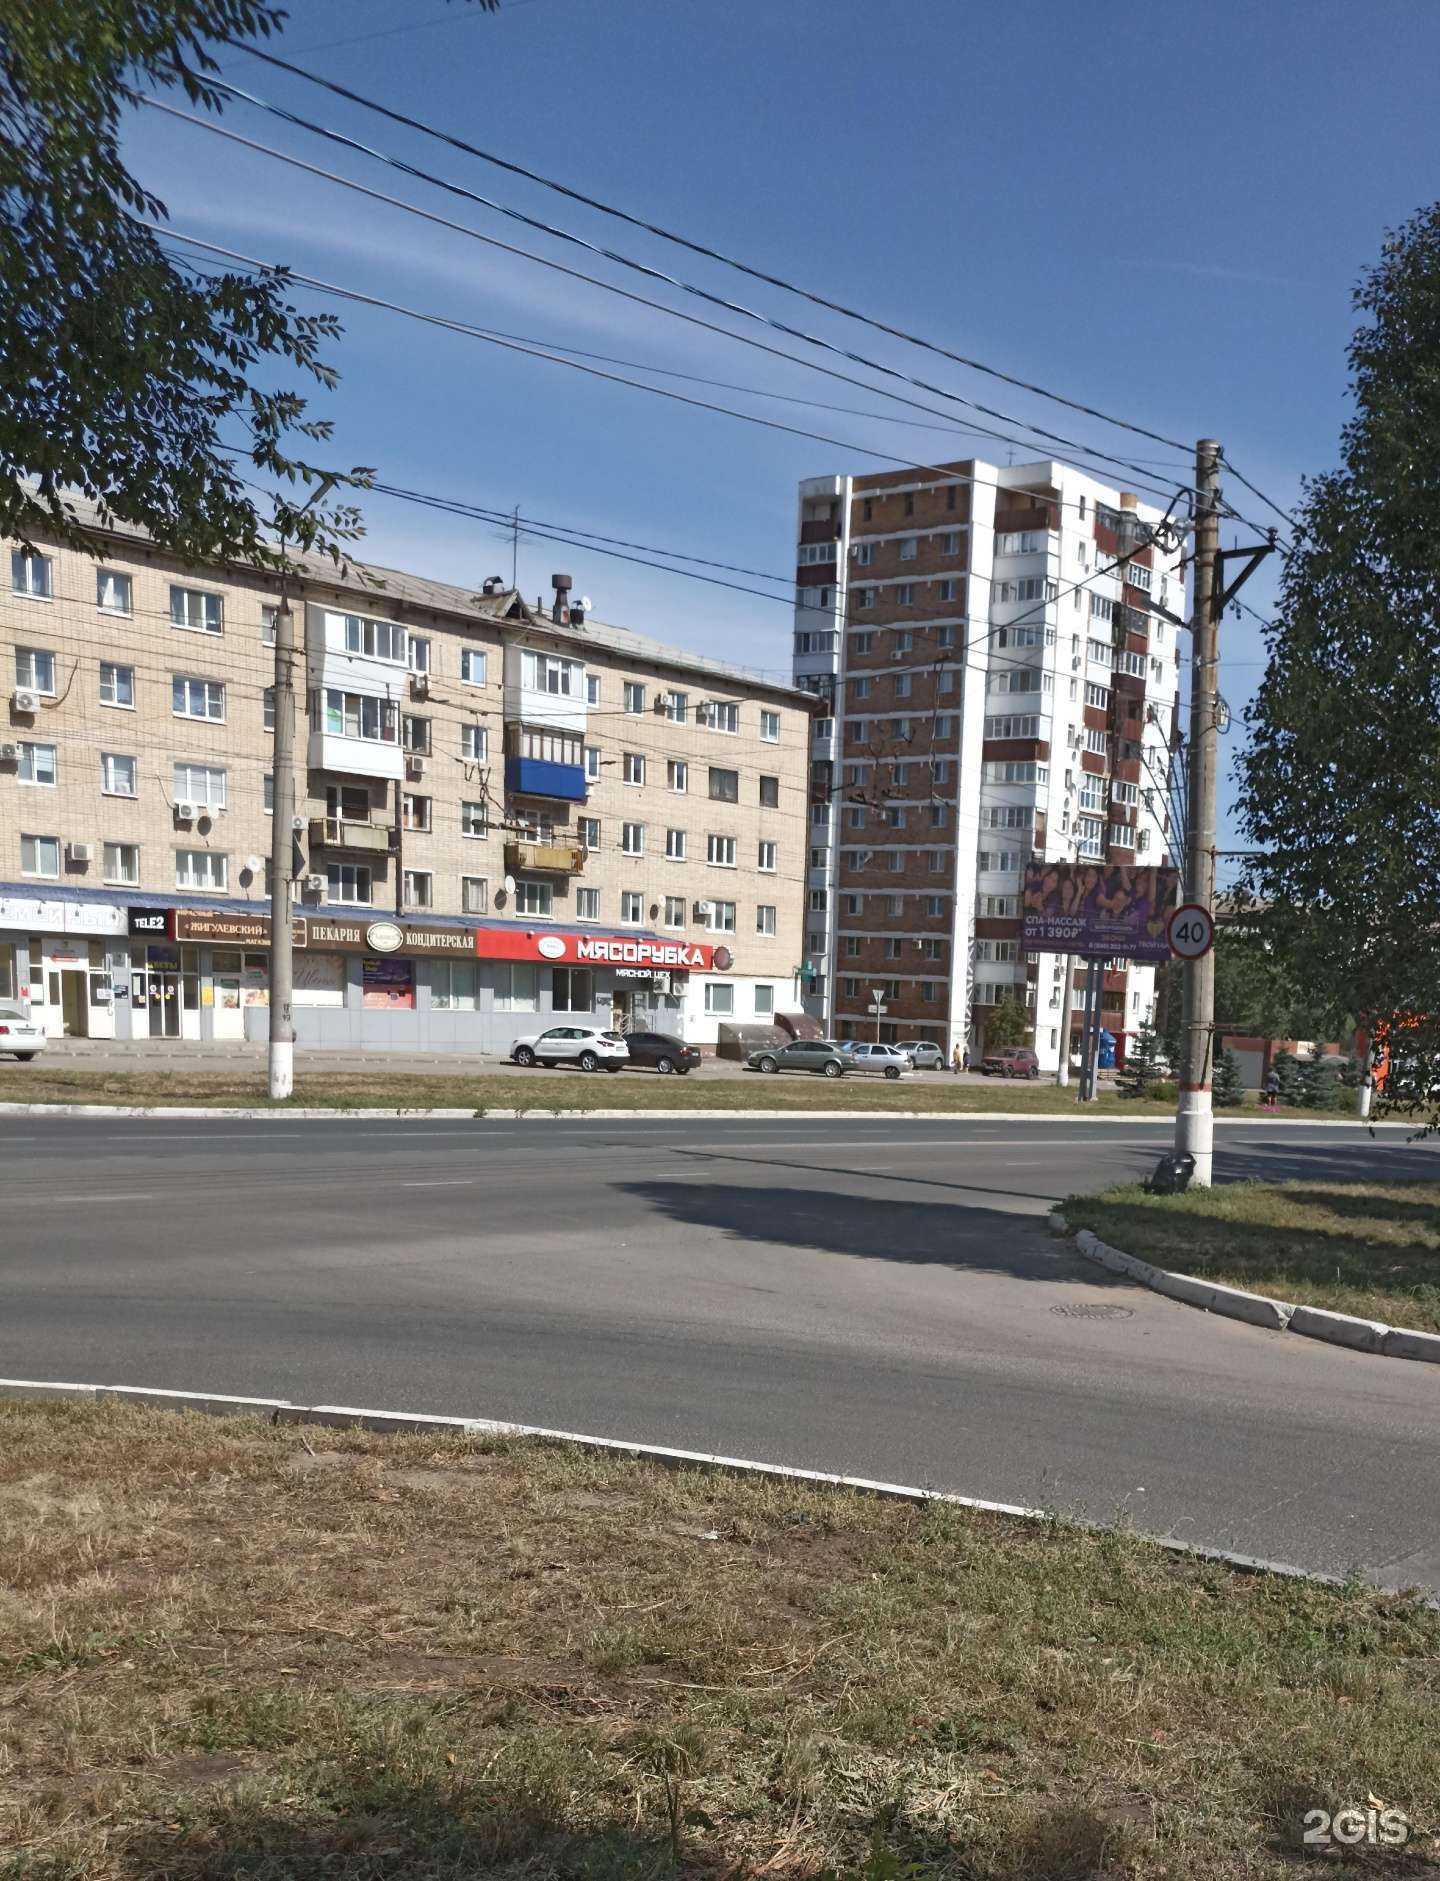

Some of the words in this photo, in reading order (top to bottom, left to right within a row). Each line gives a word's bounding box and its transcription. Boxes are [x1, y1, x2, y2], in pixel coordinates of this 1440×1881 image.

[134, 916, 164, 929] TELE2
[1025, 915, 1087, 927] СПА-МАССАЖ
[312, 926, 361, 943] ПЕКАРНЯ
[405, 932, 475, 949] КОНДИТЕРСКАЯ
[1175, 922, 1204, 943] 40
[576, 940, 705, 966] МЯСОРУБКА
[615, 968, 652, 979] МЯСНОЙ
